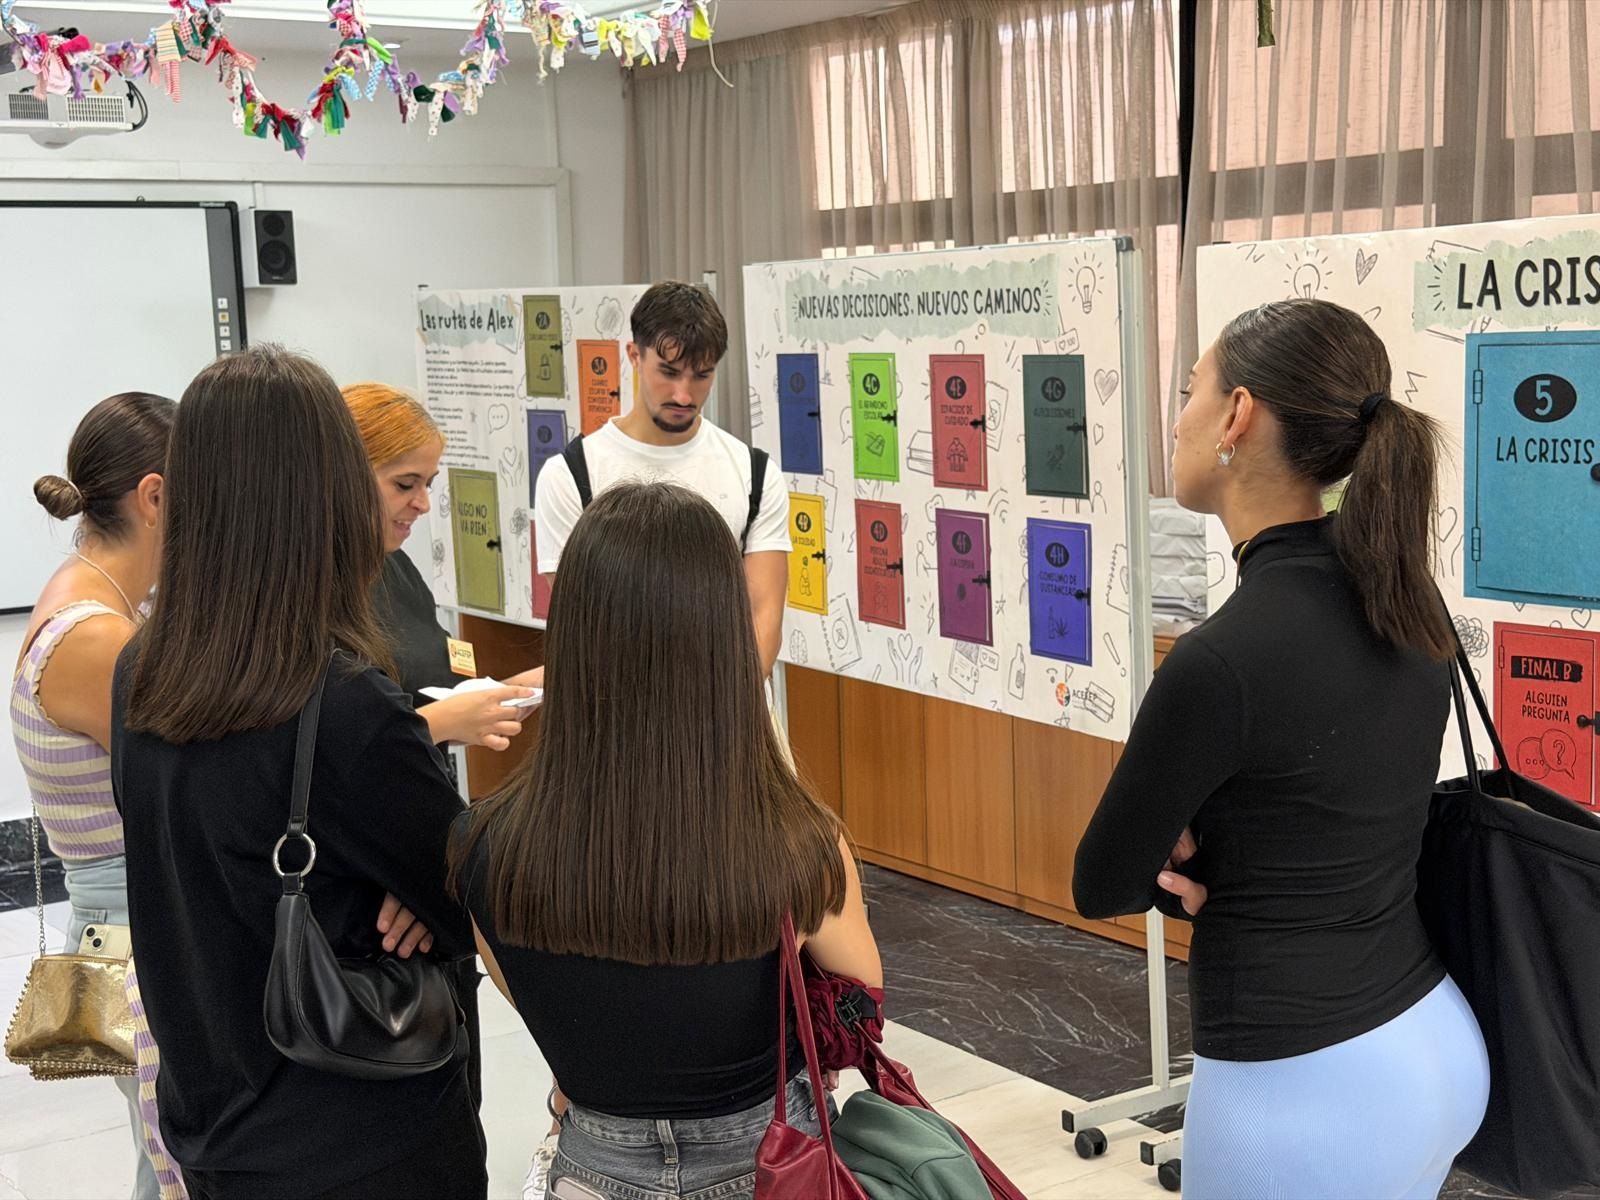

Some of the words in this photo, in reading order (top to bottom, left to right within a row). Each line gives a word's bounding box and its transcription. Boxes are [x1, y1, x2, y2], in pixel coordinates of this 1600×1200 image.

[1457, 259, 1502, 311] LA
[798, 295, 840, 319] NUEVAS
[917, 290, 969, 316] NUEVOS
[973, 287, 1042, 316] CAMINOS
[420, 309, 437, 332] Las
[438, 309, 467, 330] rutas
[470, 309, 483, 330] de
[486, 307, 514, 333] Alex
[864, 375, 878, 393] 4C
[1535, 379, 1553, 417] 5
[1496, 436, 1518, 463] LA
[1524, 437, 1595, 465] CRISIS
[475, 503, 488, 519] NO
[1521, 657, 1559, 679] FINAL
[1563, 663, 1572, 680] B
[1525, 690, 1568, 708] ALGUIEN
[1521, 705, 1571, 724] PREGUNTA
